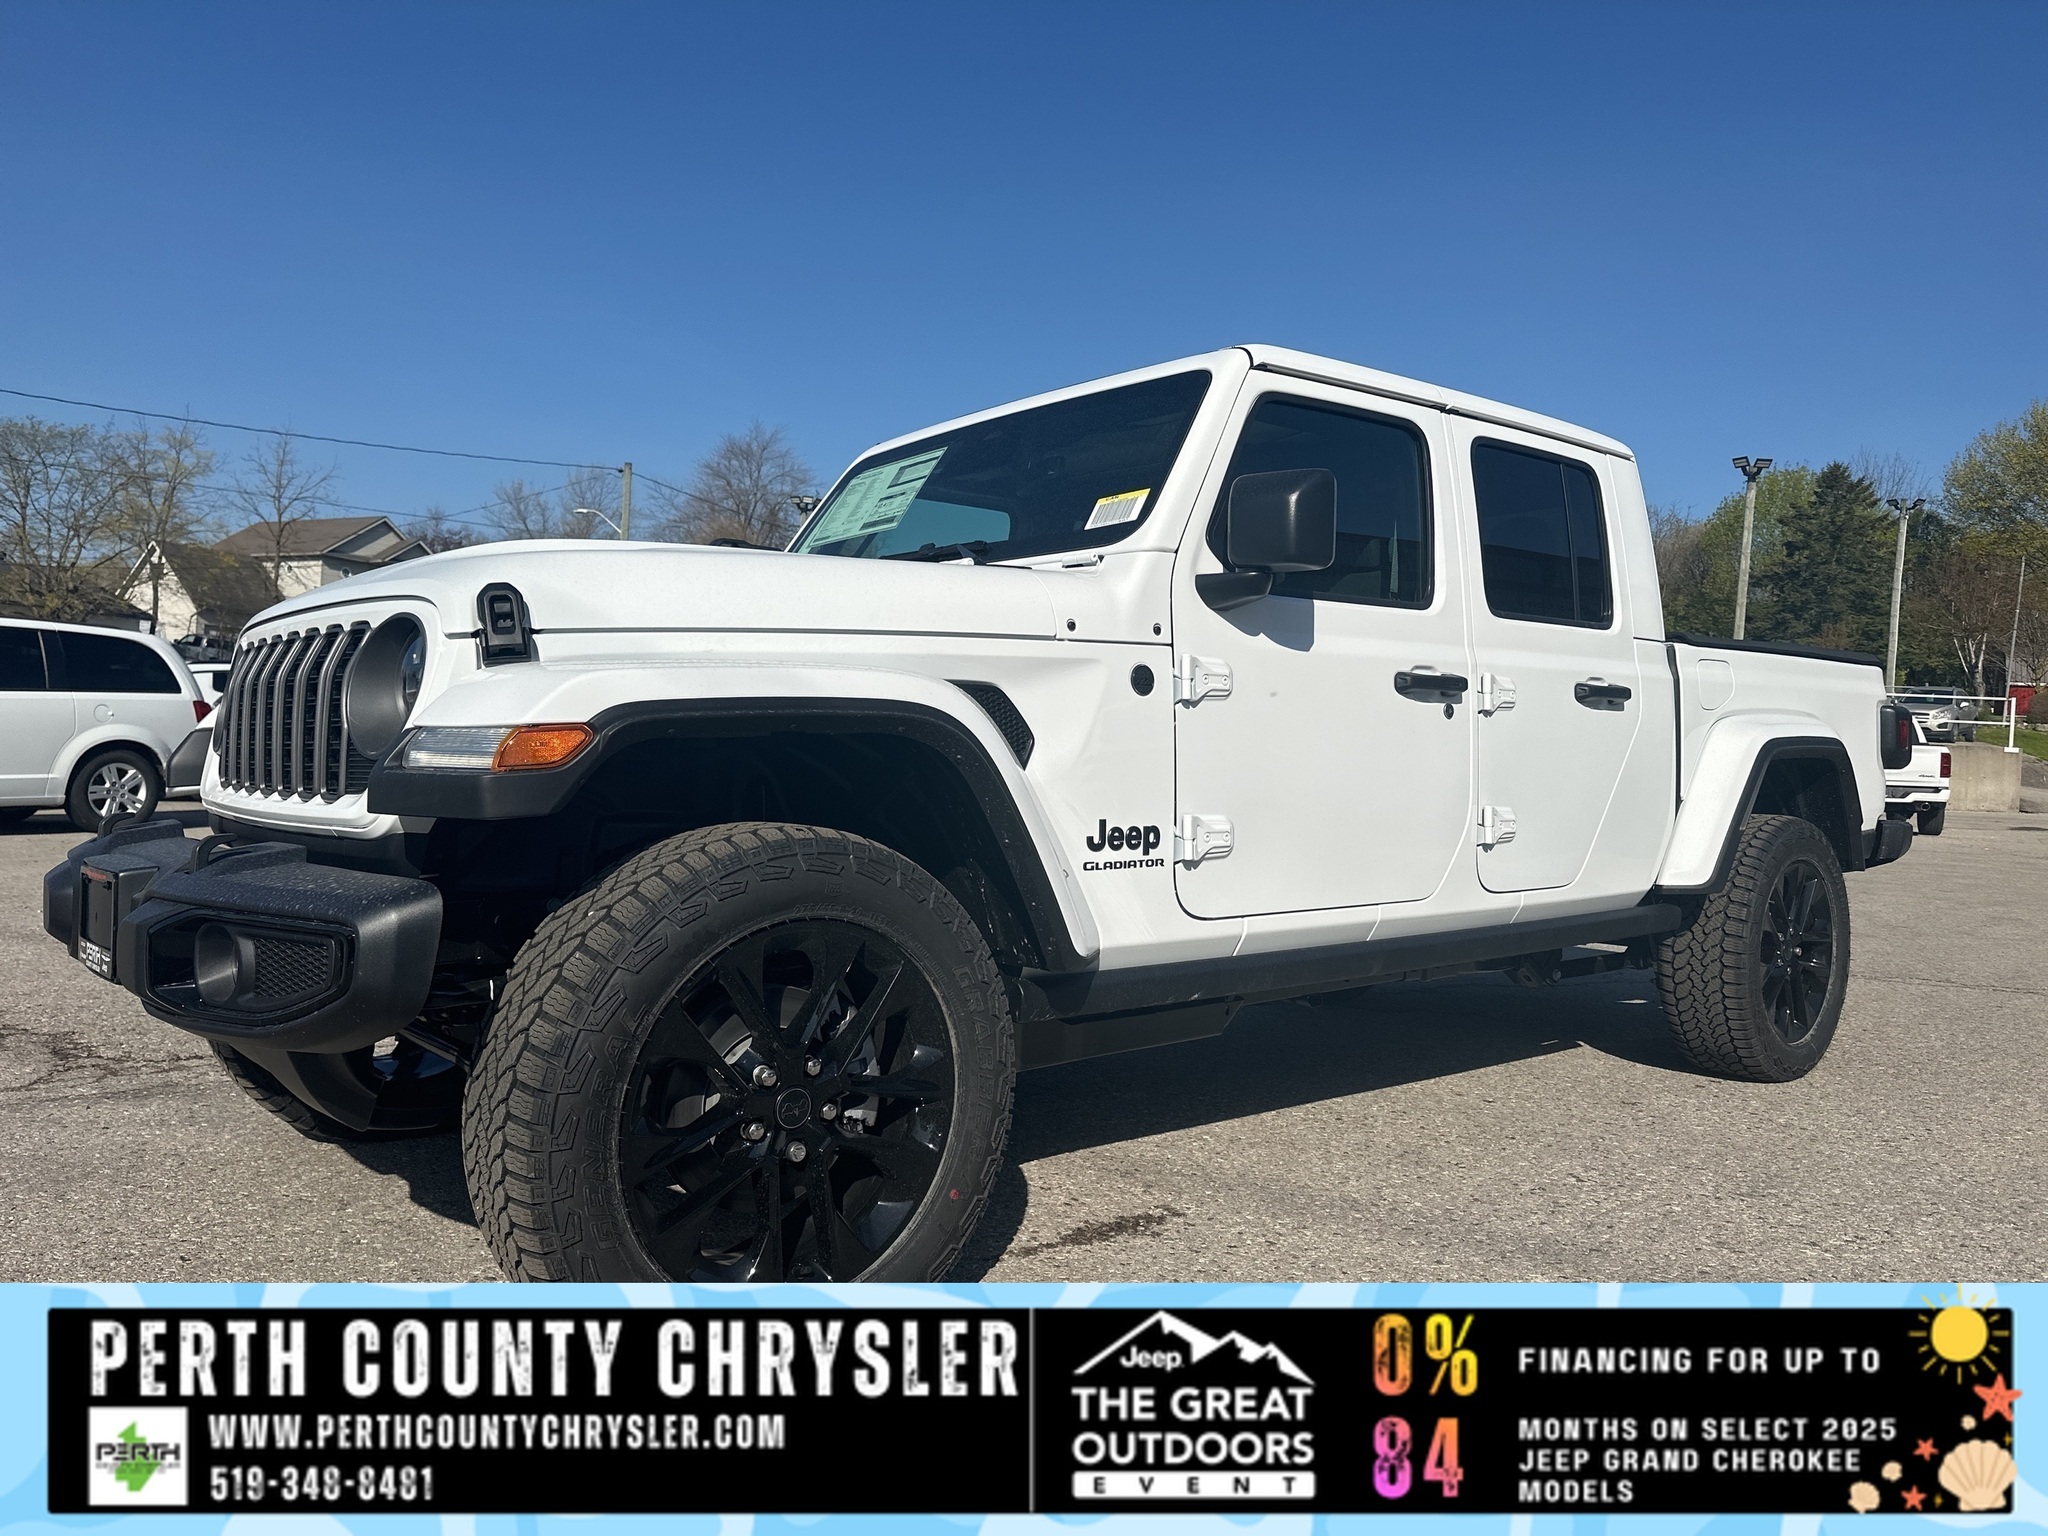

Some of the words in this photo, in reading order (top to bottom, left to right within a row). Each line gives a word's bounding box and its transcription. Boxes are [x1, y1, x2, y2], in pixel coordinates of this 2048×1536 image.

[1083, 859, 1165, 872] GLADIATOR
[1086, 819, 1161, 856] Jeep
[953, 964, 996, 1164] GRABBER
[580, 1004, 649, 1251] GENERAL
